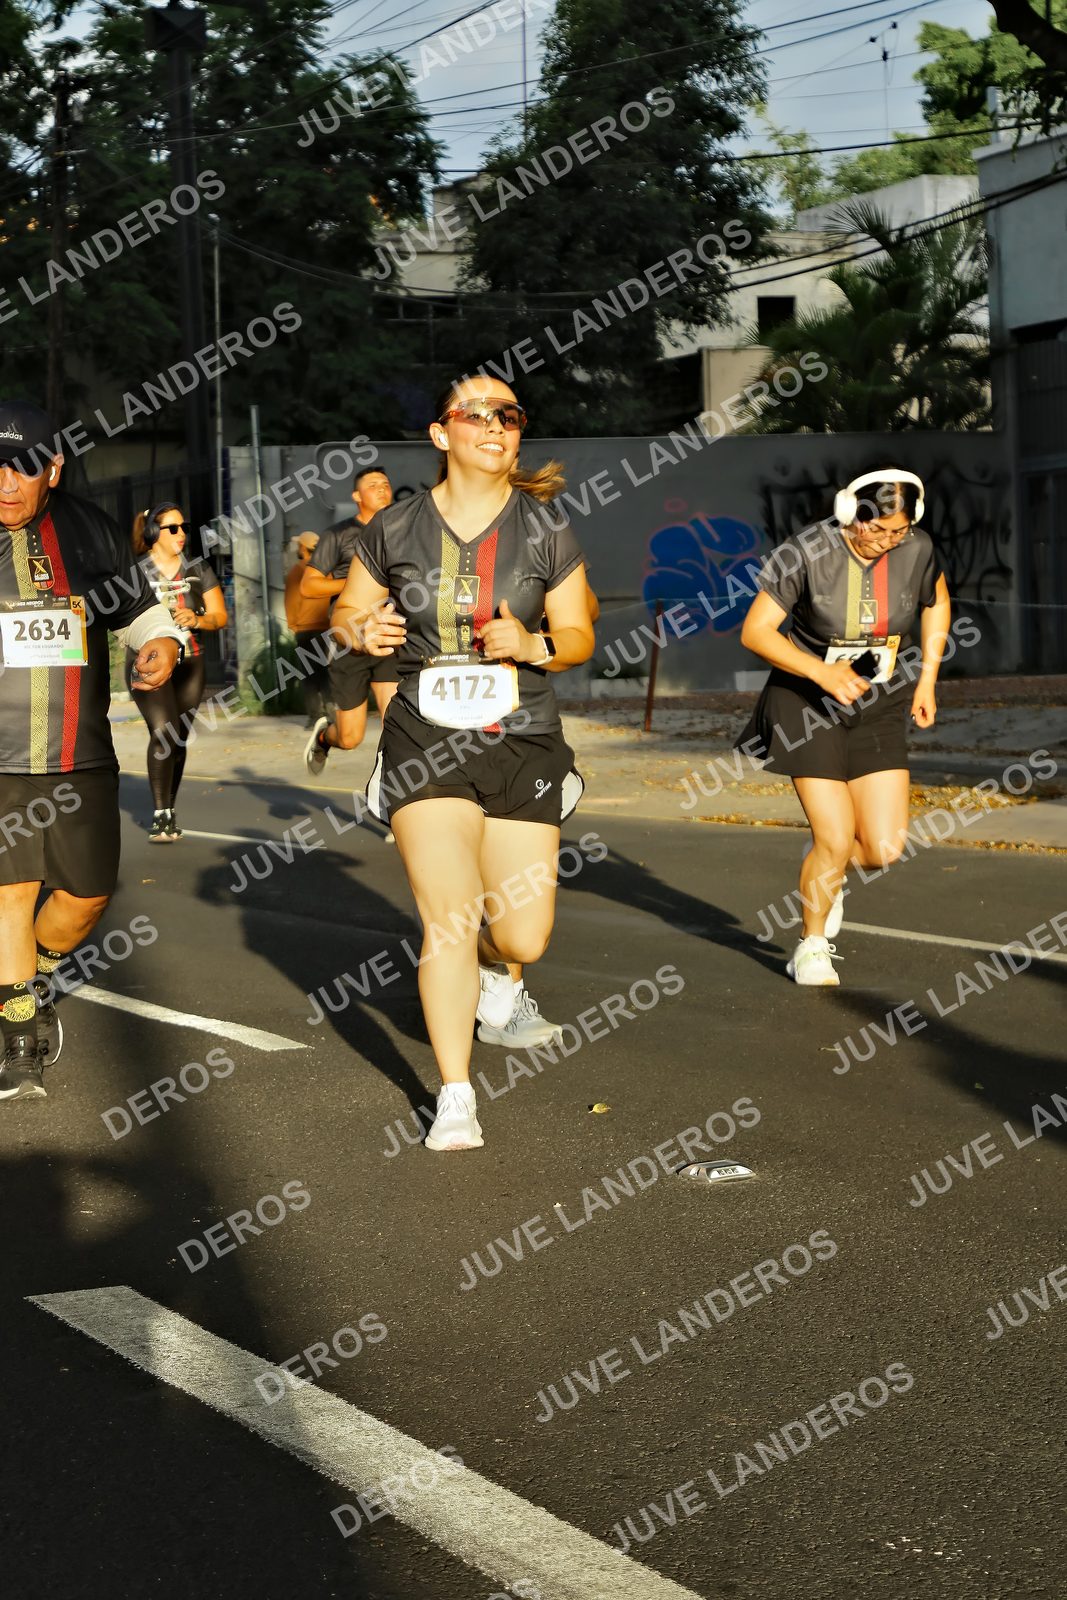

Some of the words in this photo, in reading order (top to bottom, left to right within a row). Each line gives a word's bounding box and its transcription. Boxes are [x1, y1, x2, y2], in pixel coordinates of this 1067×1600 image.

[72, 601, 82, 609] 5K
[13, 618, 71, 641] 2634
[431, 674, 497, 701] 4172
